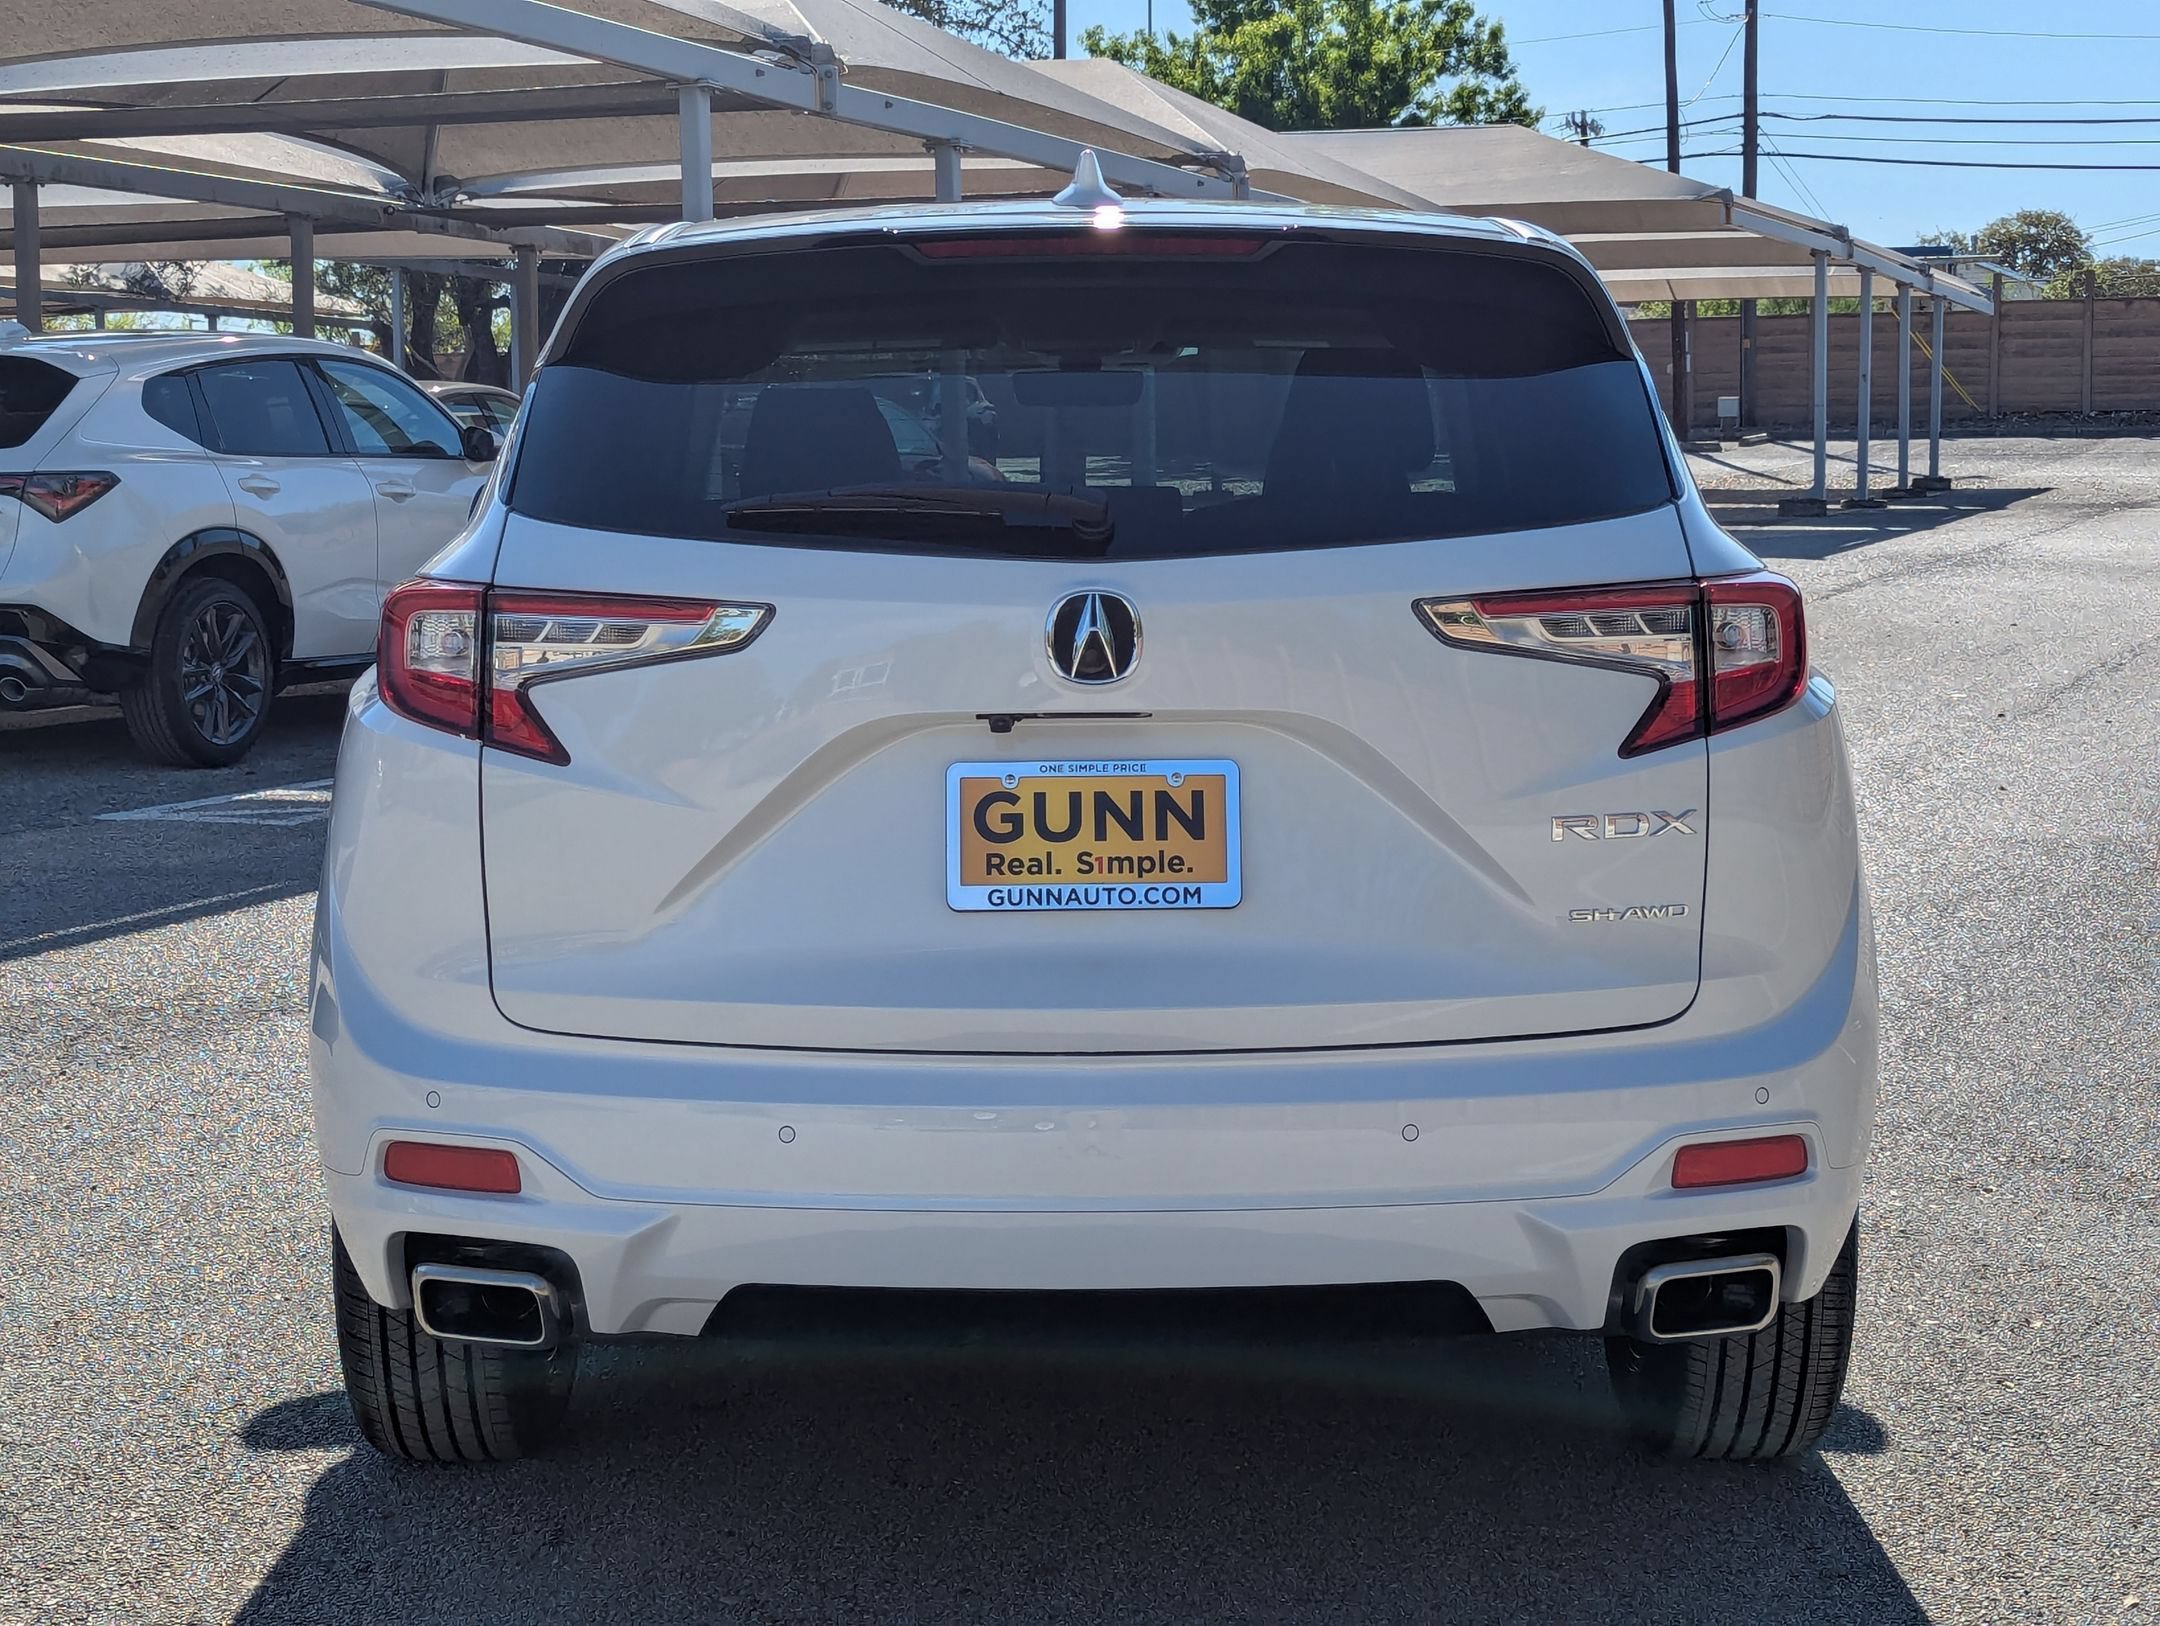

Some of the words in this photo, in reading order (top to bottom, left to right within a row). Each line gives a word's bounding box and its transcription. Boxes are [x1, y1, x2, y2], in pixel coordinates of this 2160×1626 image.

[1039, 763, 1065, 773] ONE
[1068, 763, 1109, 773] SIMPLE
[1113, 763, 1147, 773] PRICE
[973, 790, 1206, 844] GUNN
[1551, 809, 1698, 842] RDX
[985, 851, 1062, 876] Real.
[987, 886, 1202, 907] GUNNAUTO.COM
